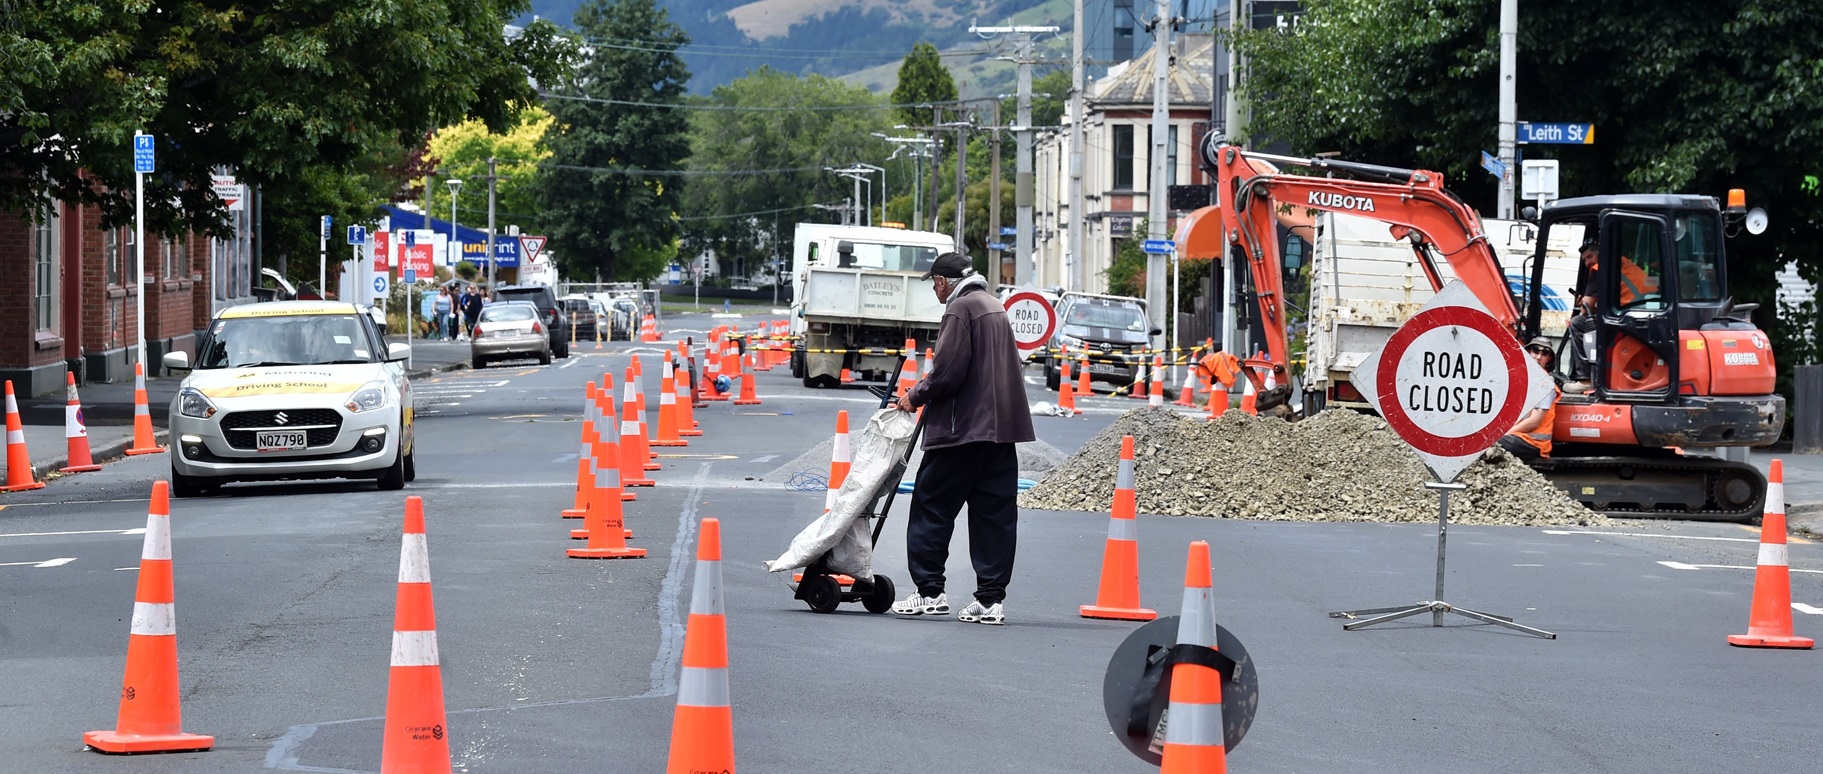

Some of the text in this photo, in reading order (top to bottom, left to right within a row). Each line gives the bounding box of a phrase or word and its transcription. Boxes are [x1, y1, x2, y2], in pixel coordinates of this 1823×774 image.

[1528, 124, 1583, 141] Leith St
[1308, 190, 1375, 212] KUBOTA
[1015, 309, 1039, 321] ROAD
[1423, 351, 1482, 380] ROAD
[1724, 352, 1759, 365] KUBOTA
[236, 382, 282, 391] Driving
[1409, 384, 1493, 415] CLOSED
[259, 434, 304, 447] NQZ790
